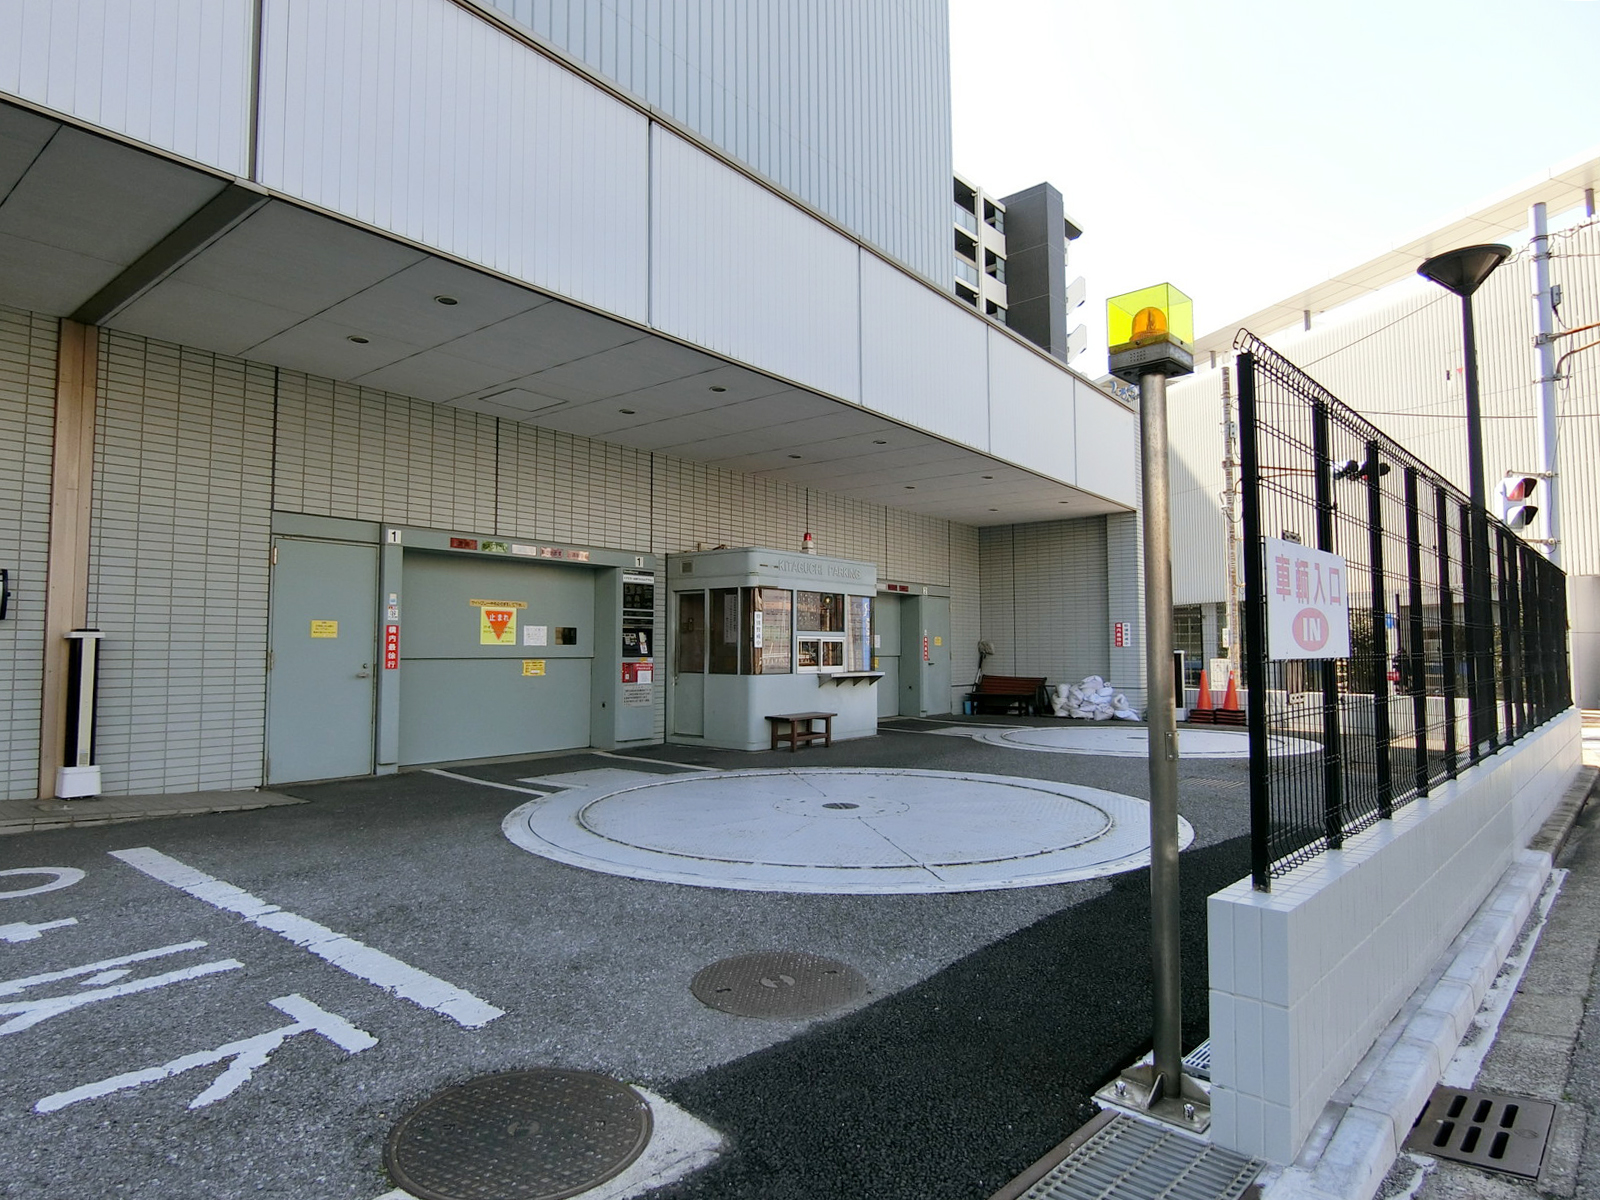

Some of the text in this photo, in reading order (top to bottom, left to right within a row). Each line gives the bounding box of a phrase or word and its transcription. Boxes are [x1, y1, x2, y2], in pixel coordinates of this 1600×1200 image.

[778, 559, 862, 581] KITAGUCHI PARKING
[488, 613, 510, 622] 止まれ
[1301, 617, 1321, 642] IN
